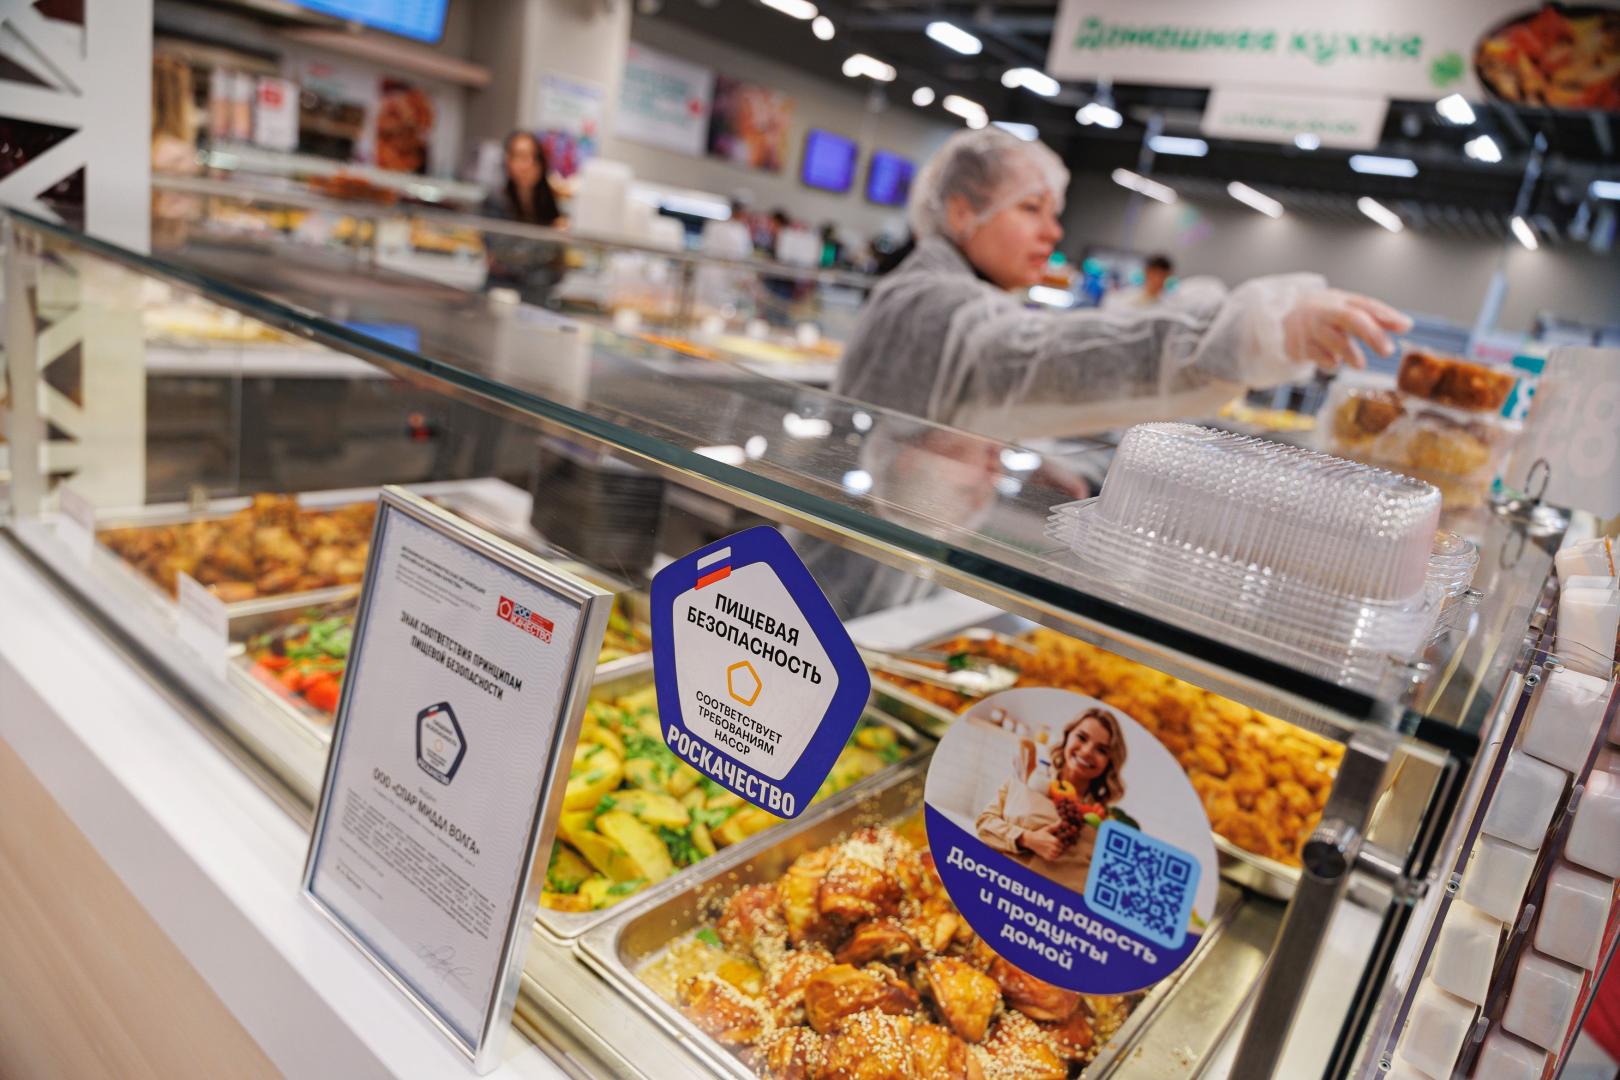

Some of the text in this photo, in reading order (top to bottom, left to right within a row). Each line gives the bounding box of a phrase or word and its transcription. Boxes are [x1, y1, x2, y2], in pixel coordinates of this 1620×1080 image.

[511, 613, 552, 645] КАЧЕСТВО
[687, 606, 822, 685] БЕЗОПАСНОСТЬ
[714, 593, 799, 646] ПИЩЕВАЯ
[401, 610, 522, 692] ЗНАК СООТВЕТСТВИЯ ПРИНЦИПАМ
[411, 635, 503, 701] ПИЩЕВОЙ БЕЗОПАСНОСТИ
[695, 690, 783, 744] СООТВЕТСТВУЕТ
[698, 705, 774, 756] ТРЕБОВАНИЯМ
[714, 729, 751, 755] НАССР
[373, 767, 391, 788] ООО
[667, 724, 795, 817] РОСКАЧЕСТВО
[946, 846, 1158, 965] Доставим радость
[979, 888, 1109, 965] и продукты
[1000, 924, 1073, 971] домой
